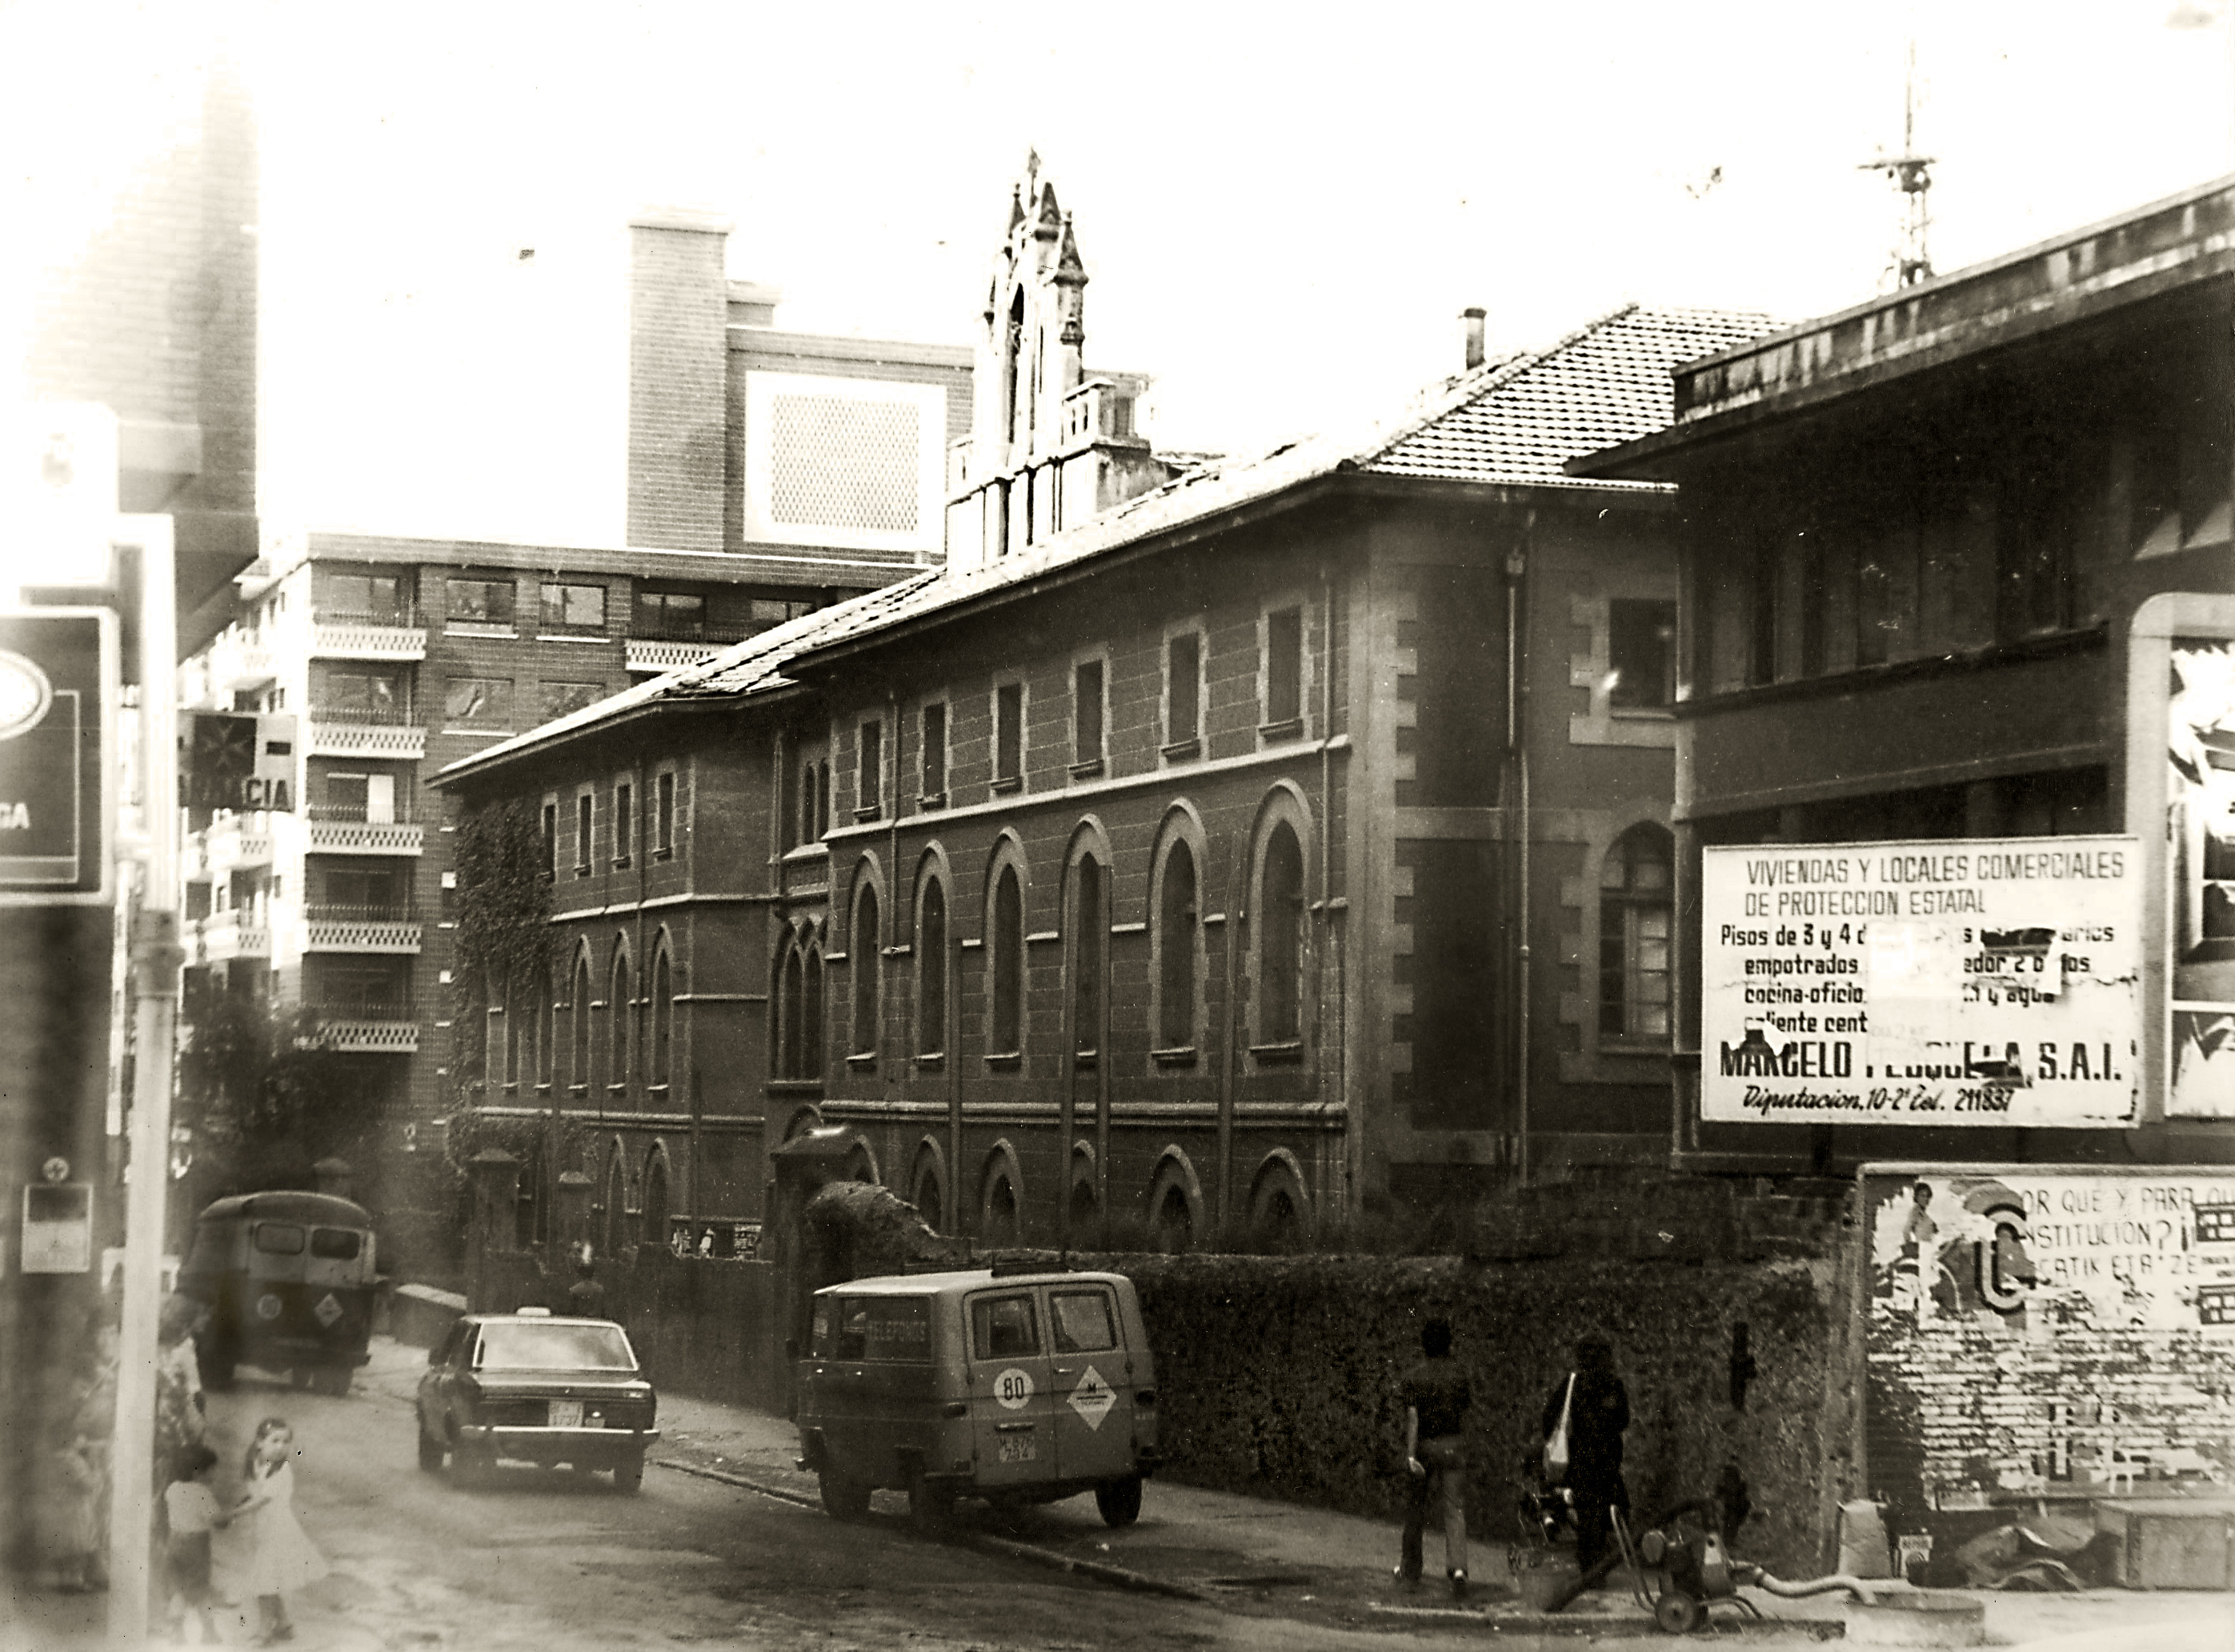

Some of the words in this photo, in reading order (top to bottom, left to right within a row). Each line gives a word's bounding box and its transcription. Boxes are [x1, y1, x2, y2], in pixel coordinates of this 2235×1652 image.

[1747, 859, 1848, 886] VIVIENDAS
[1858, 858, 1871, 882] Y
[1881, 855, 1969, 882] LOCALES
[1977, 852, 2124, 879] COMERCIALES
[1745, 893, 1769, 916] DE
[1779, 891, 1899, 916] PROTECCION
[1910, 889, 1986, 914] ESTATAL
[1721, 924, 1768, 946] Pisos
[1776, 924, 1796, 946] de
[1804, 923, 1813, 945] 3
[1821, 930, 1832, 950] y
[1840, 923, 1851, 944] 4
[1744, 954, 1858, 978] empotrados
[2062, 1190, 2102, 1214] QUE
[2142, 1186, 2193, 1214] PARA
[1004, 1376, 1023, 1400] 80
